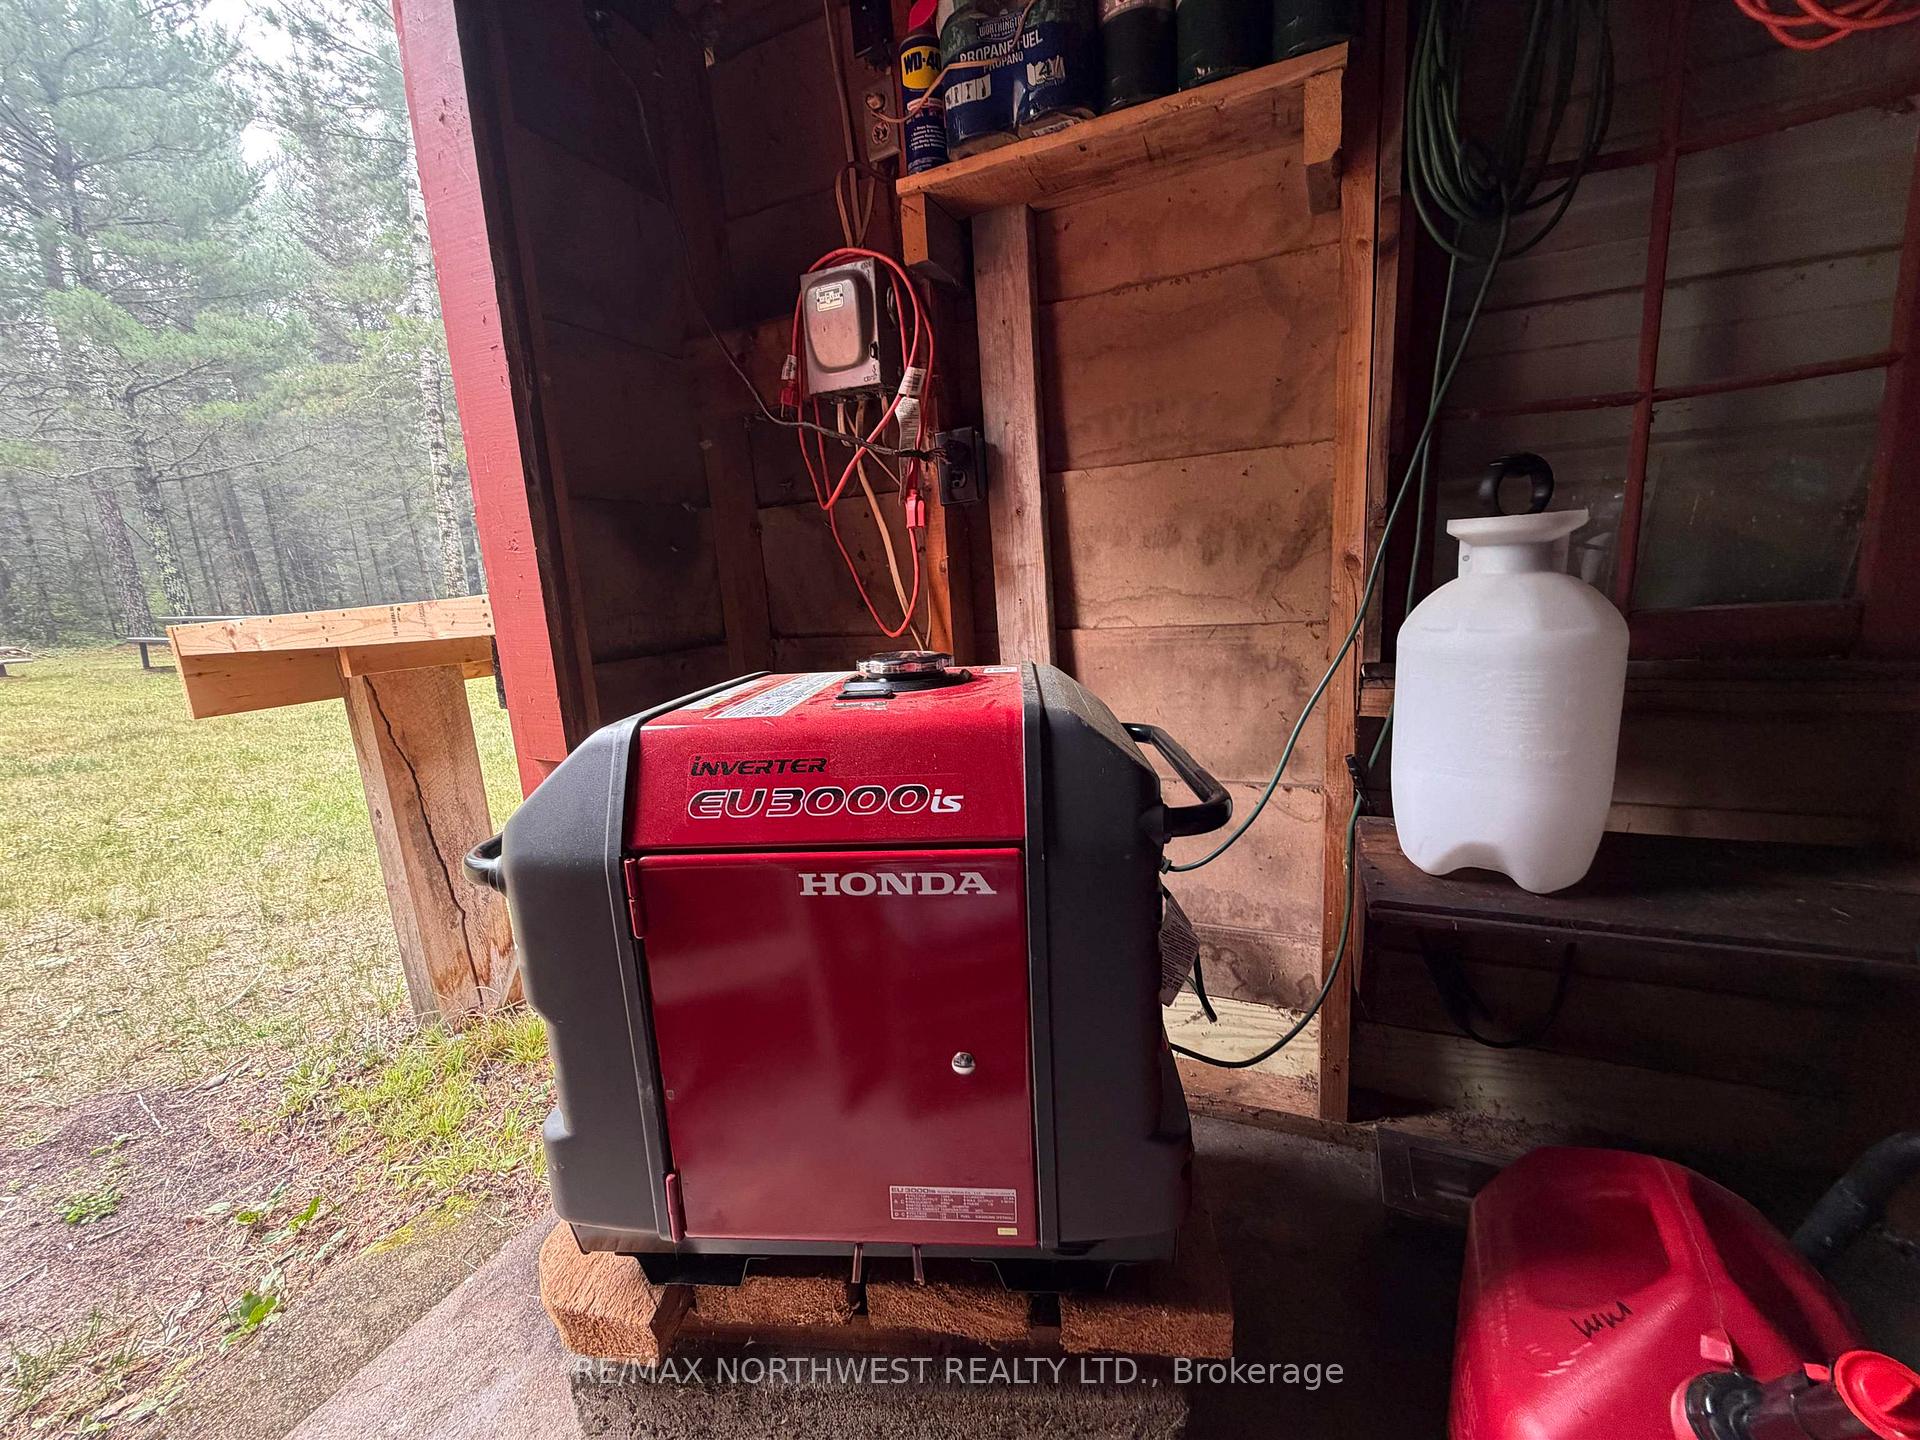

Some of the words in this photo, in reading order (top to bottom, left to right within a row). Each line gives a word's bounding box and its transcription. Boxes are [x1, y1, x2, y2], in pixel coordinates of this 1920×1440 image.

[979, 14, 1024, 36] WORTHINGTO
[904, 50, 941, 75] WD-40
[798, 872, 997, 896] HONDA
